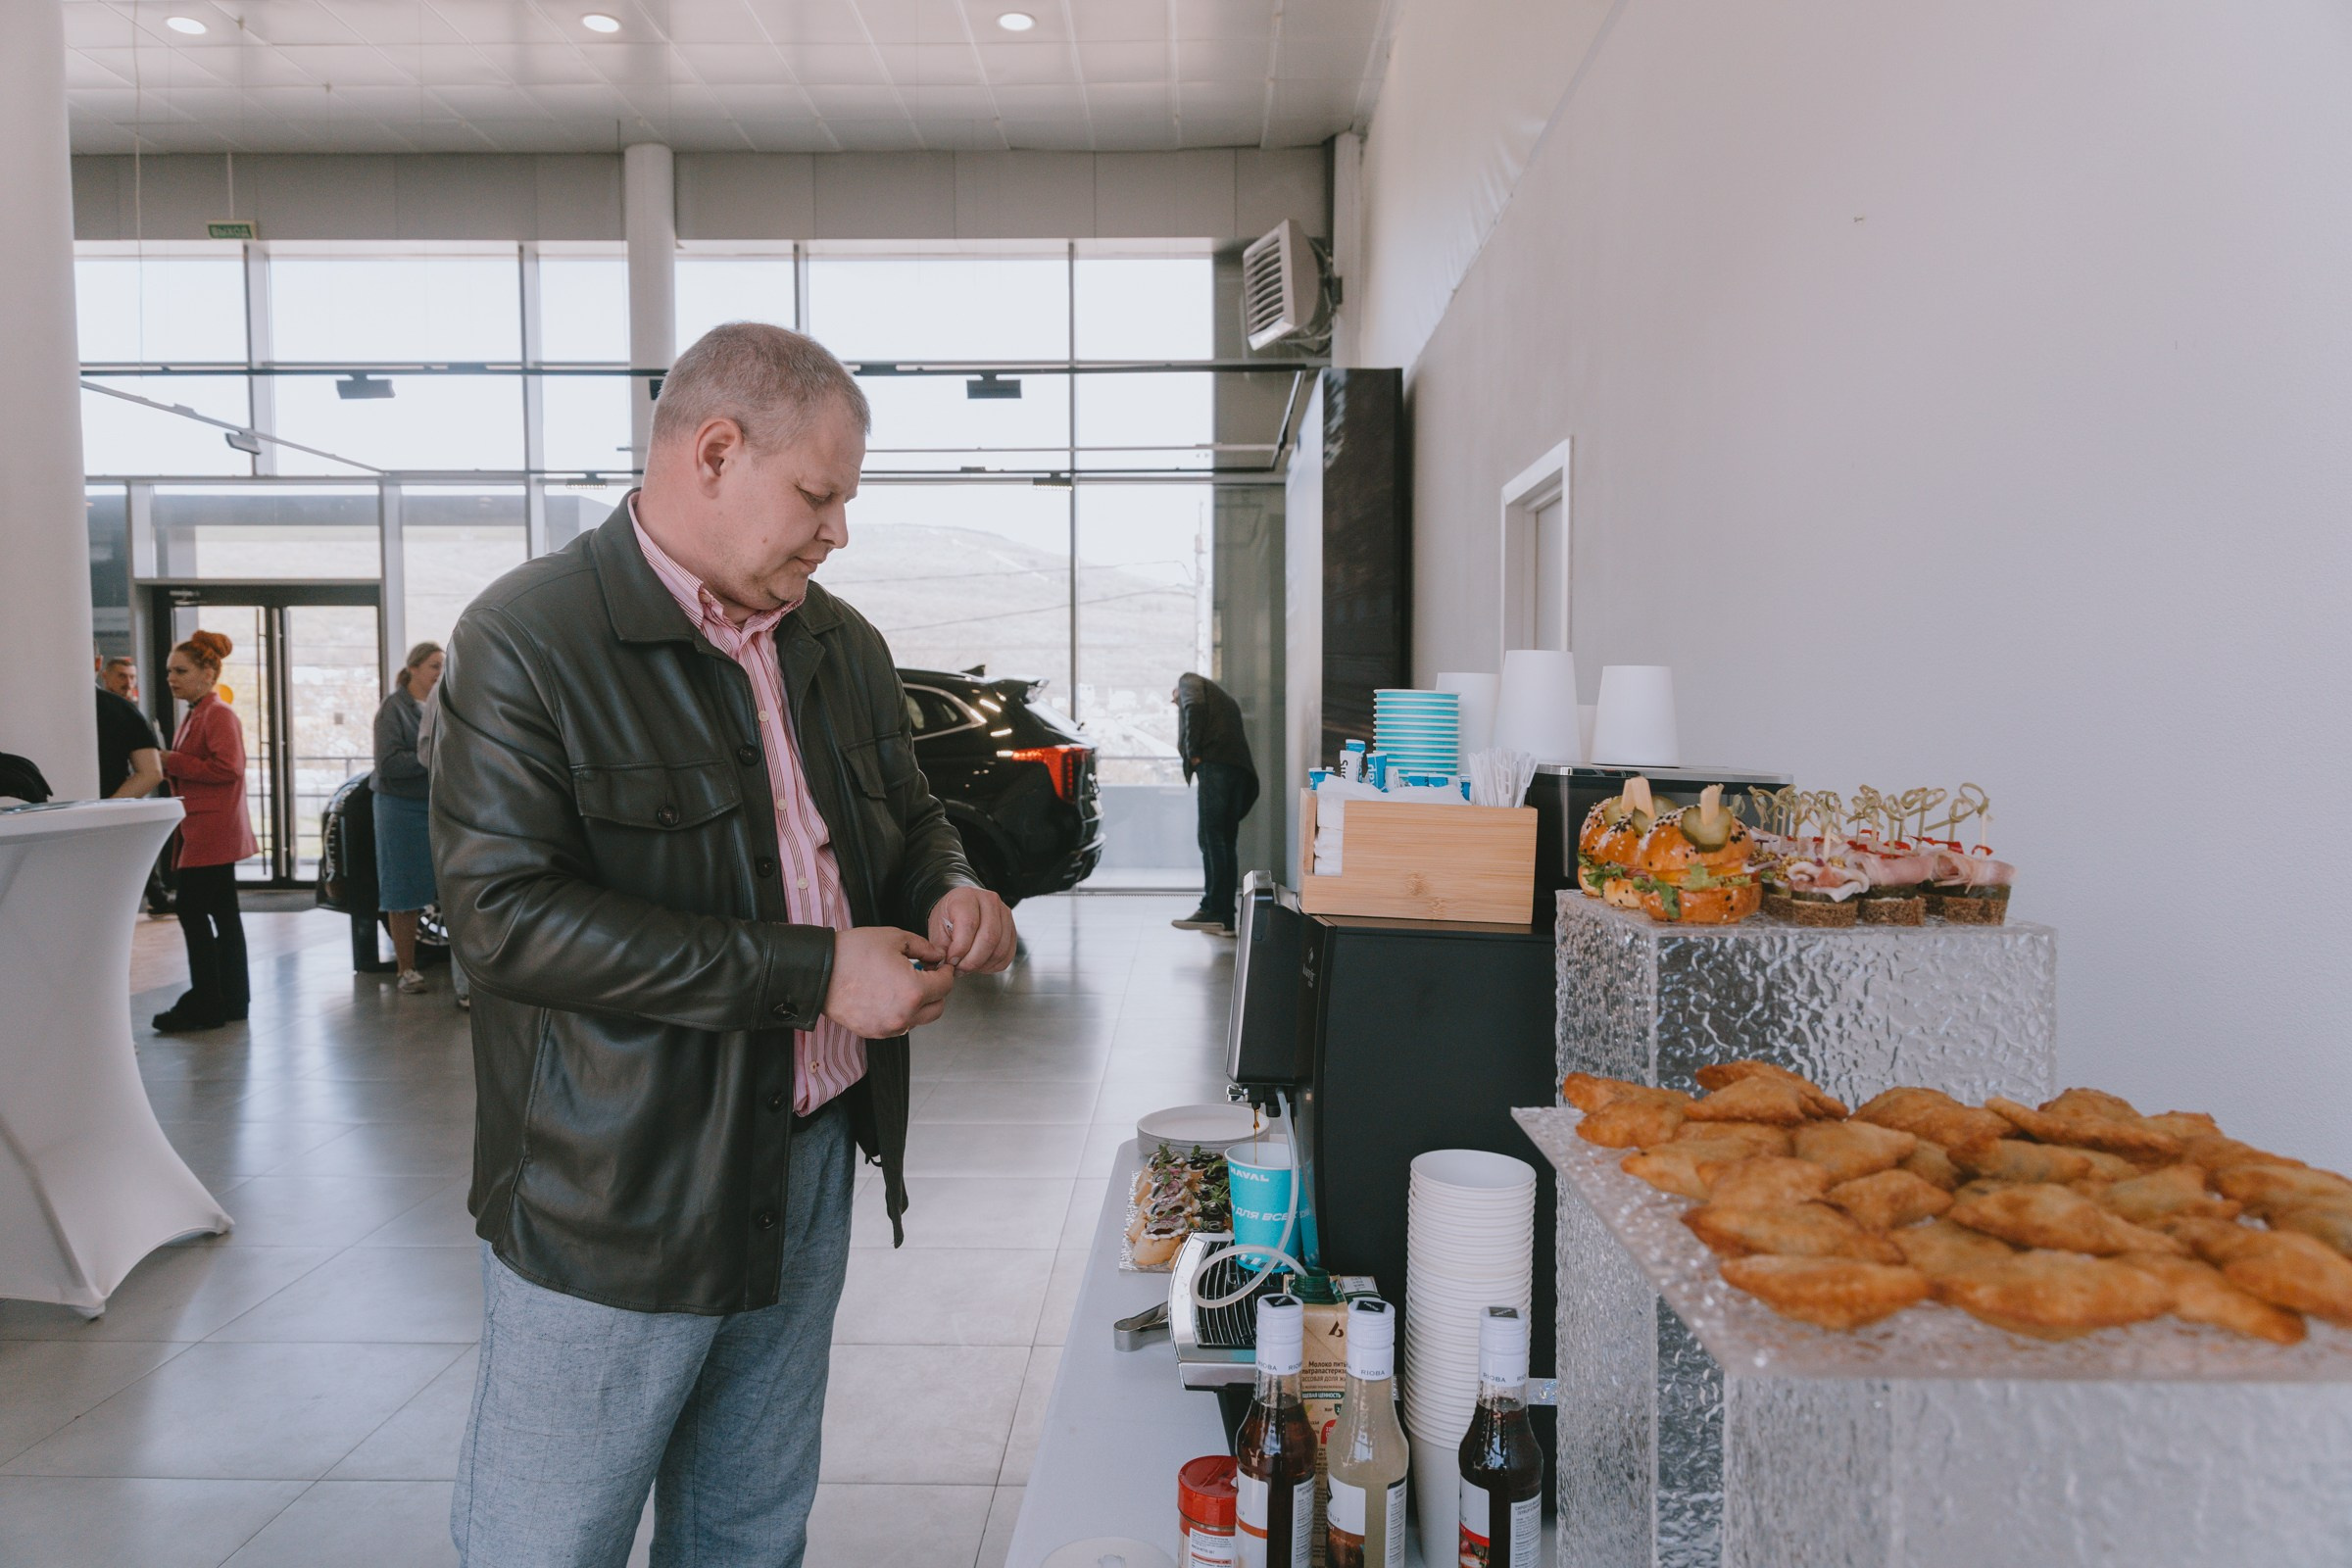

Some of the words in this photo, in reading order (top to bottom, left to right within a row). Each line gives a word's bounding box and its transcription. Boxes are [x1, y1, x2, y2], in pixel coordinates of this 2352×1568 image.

[1230, 1166, 1269, 1182] HAVAL
[1235, 1206, 1259, 1220] ДЛЯ
[1261, 1212, 1297, 1221] ВСЕ
[1288, 1361, 1301, 1371] RIO
[1483, 1372, 1506, 1383] RIOBA
